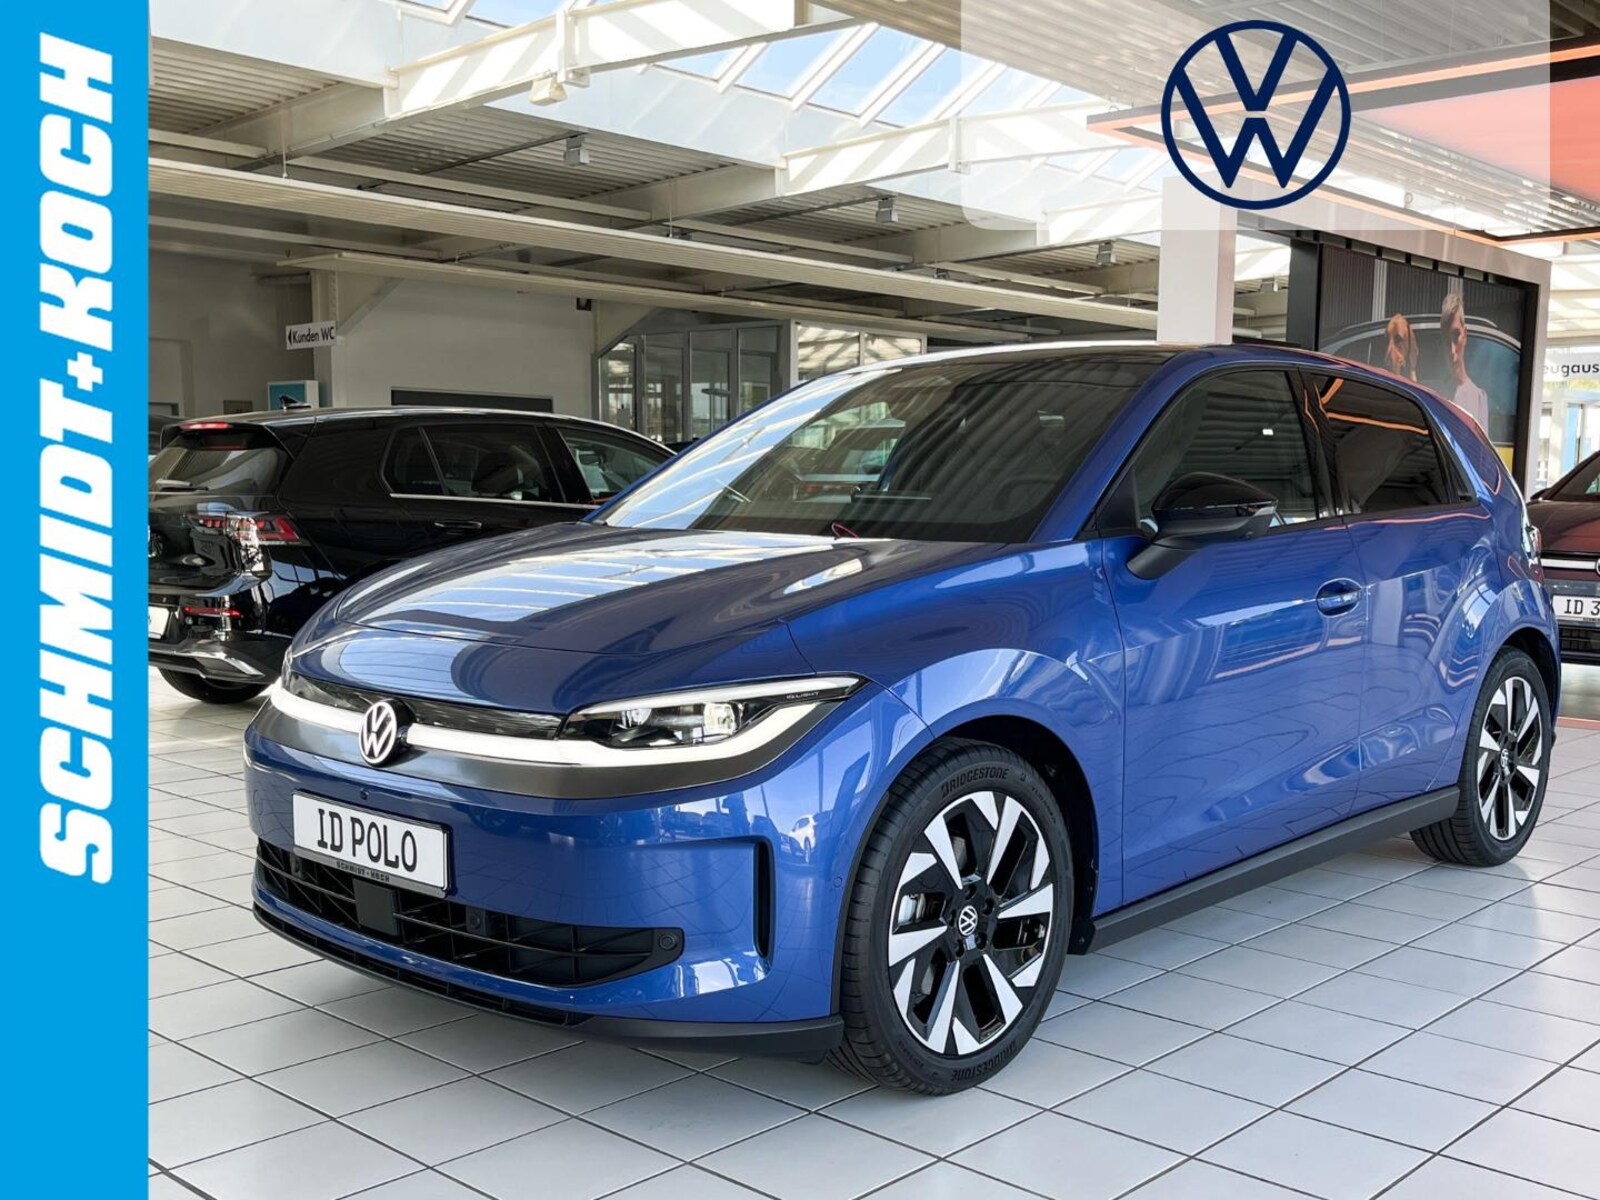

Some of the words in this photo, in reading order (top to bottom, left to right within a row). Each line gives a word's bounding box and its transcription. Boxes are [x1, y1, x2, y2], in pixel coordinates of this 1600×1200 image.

[293, 328, 320, 344] Kunden
[321, 326, 334, 341] WC
[1564, 599, 1584, 615] ID
[941, 767, 1010, 798] BRIDGESTONE
[317, 808, 344, 853] ID
[350, 816, 417, 872] POLO
